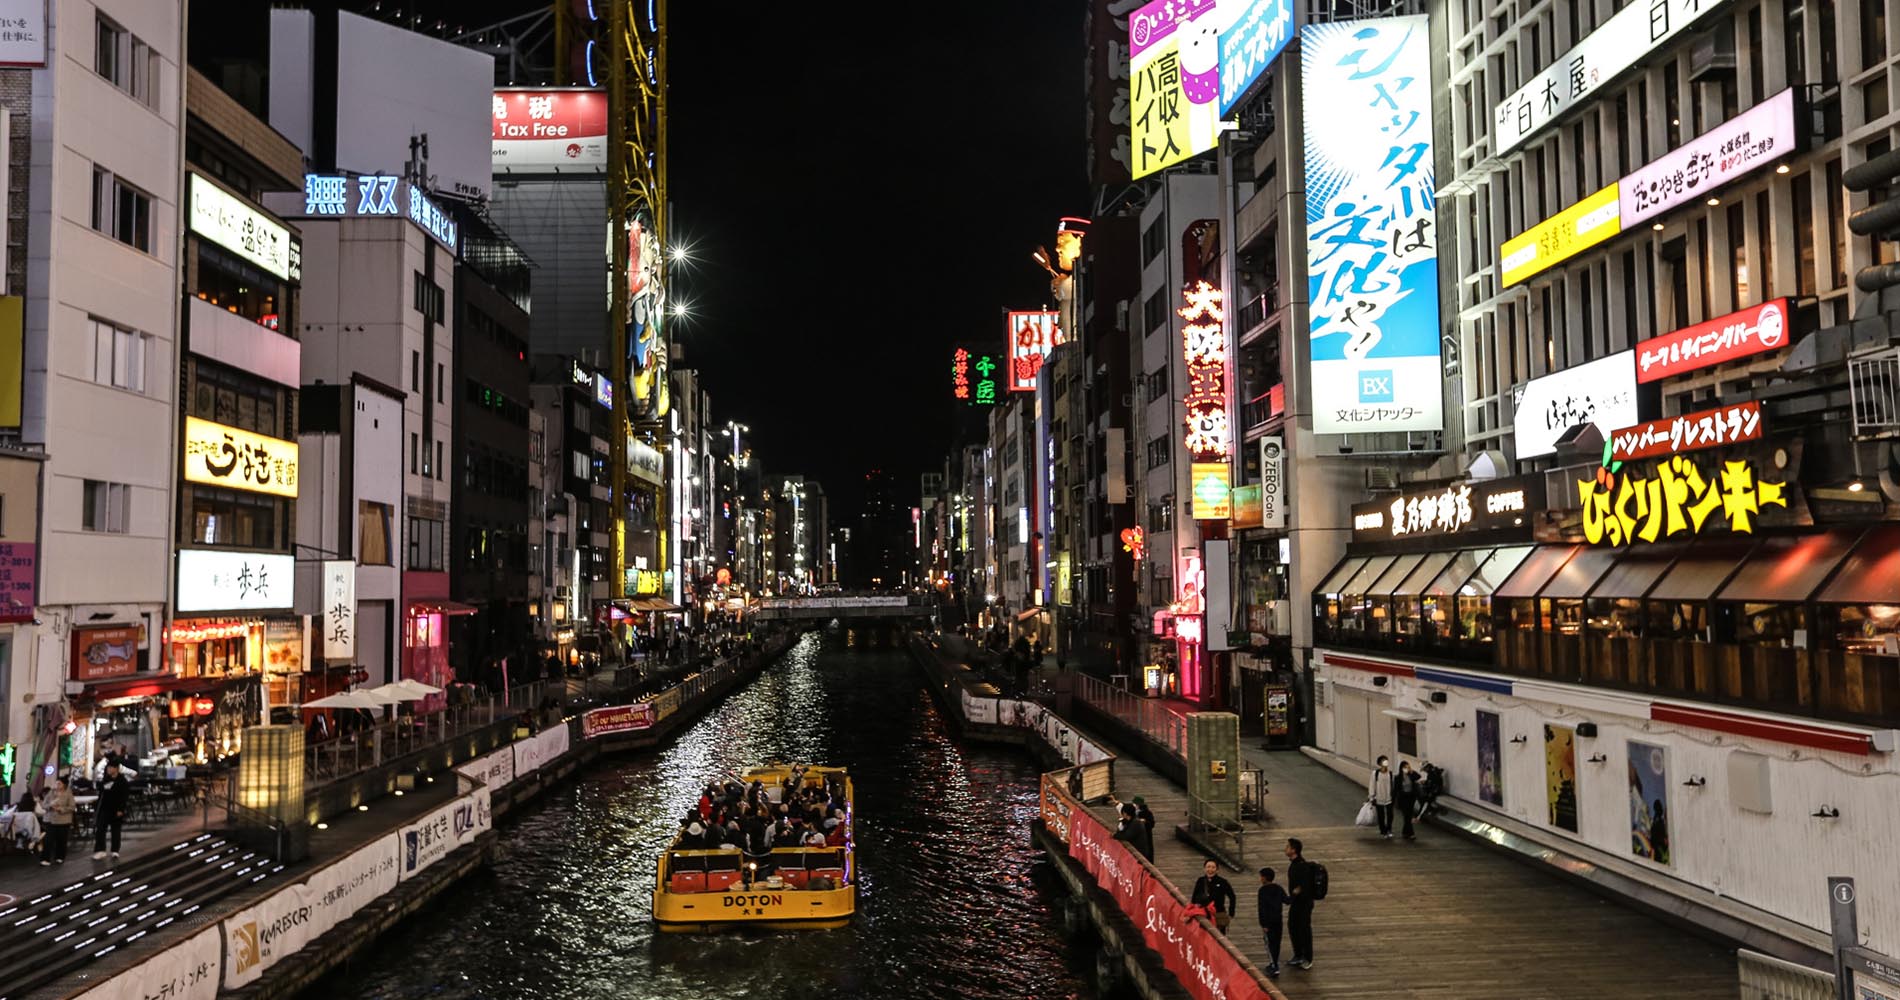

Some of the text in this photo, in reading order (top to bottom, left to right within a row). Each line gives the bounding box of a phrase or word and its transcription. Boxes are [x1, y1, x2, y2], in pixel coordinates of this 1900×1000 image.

[1136, 62, 1157, 171] バイト
[1157, 50, 1181, 164] 高収入
[1518, 54, 1588, 136] 白木屋
[500, 122, 568, 137] Tax Free
[306, 174, 398, 214] 無双
[976, 356, 995, 399] 千房
[1177, 279, 1227, 455] 大阪王将
[1362, 376, 1391, 395] BX
[1612, 408, 1760, 456] ハンバーグレストラン
[205, 432, 272, 485] うなぎ
[1265, 461, 1277, 494] ZERO
[1390, 484, 1473, 536] 星乃珈琲店
[1487, 490, 1525, 513] COFFEE
[1577, 455, 1787, 548] びっくりドンキー
[237, 561, 269, 599] 歩兵
[329, 602, 350, 645] 歩兵
[724, 894, 783, 907] DOTON
